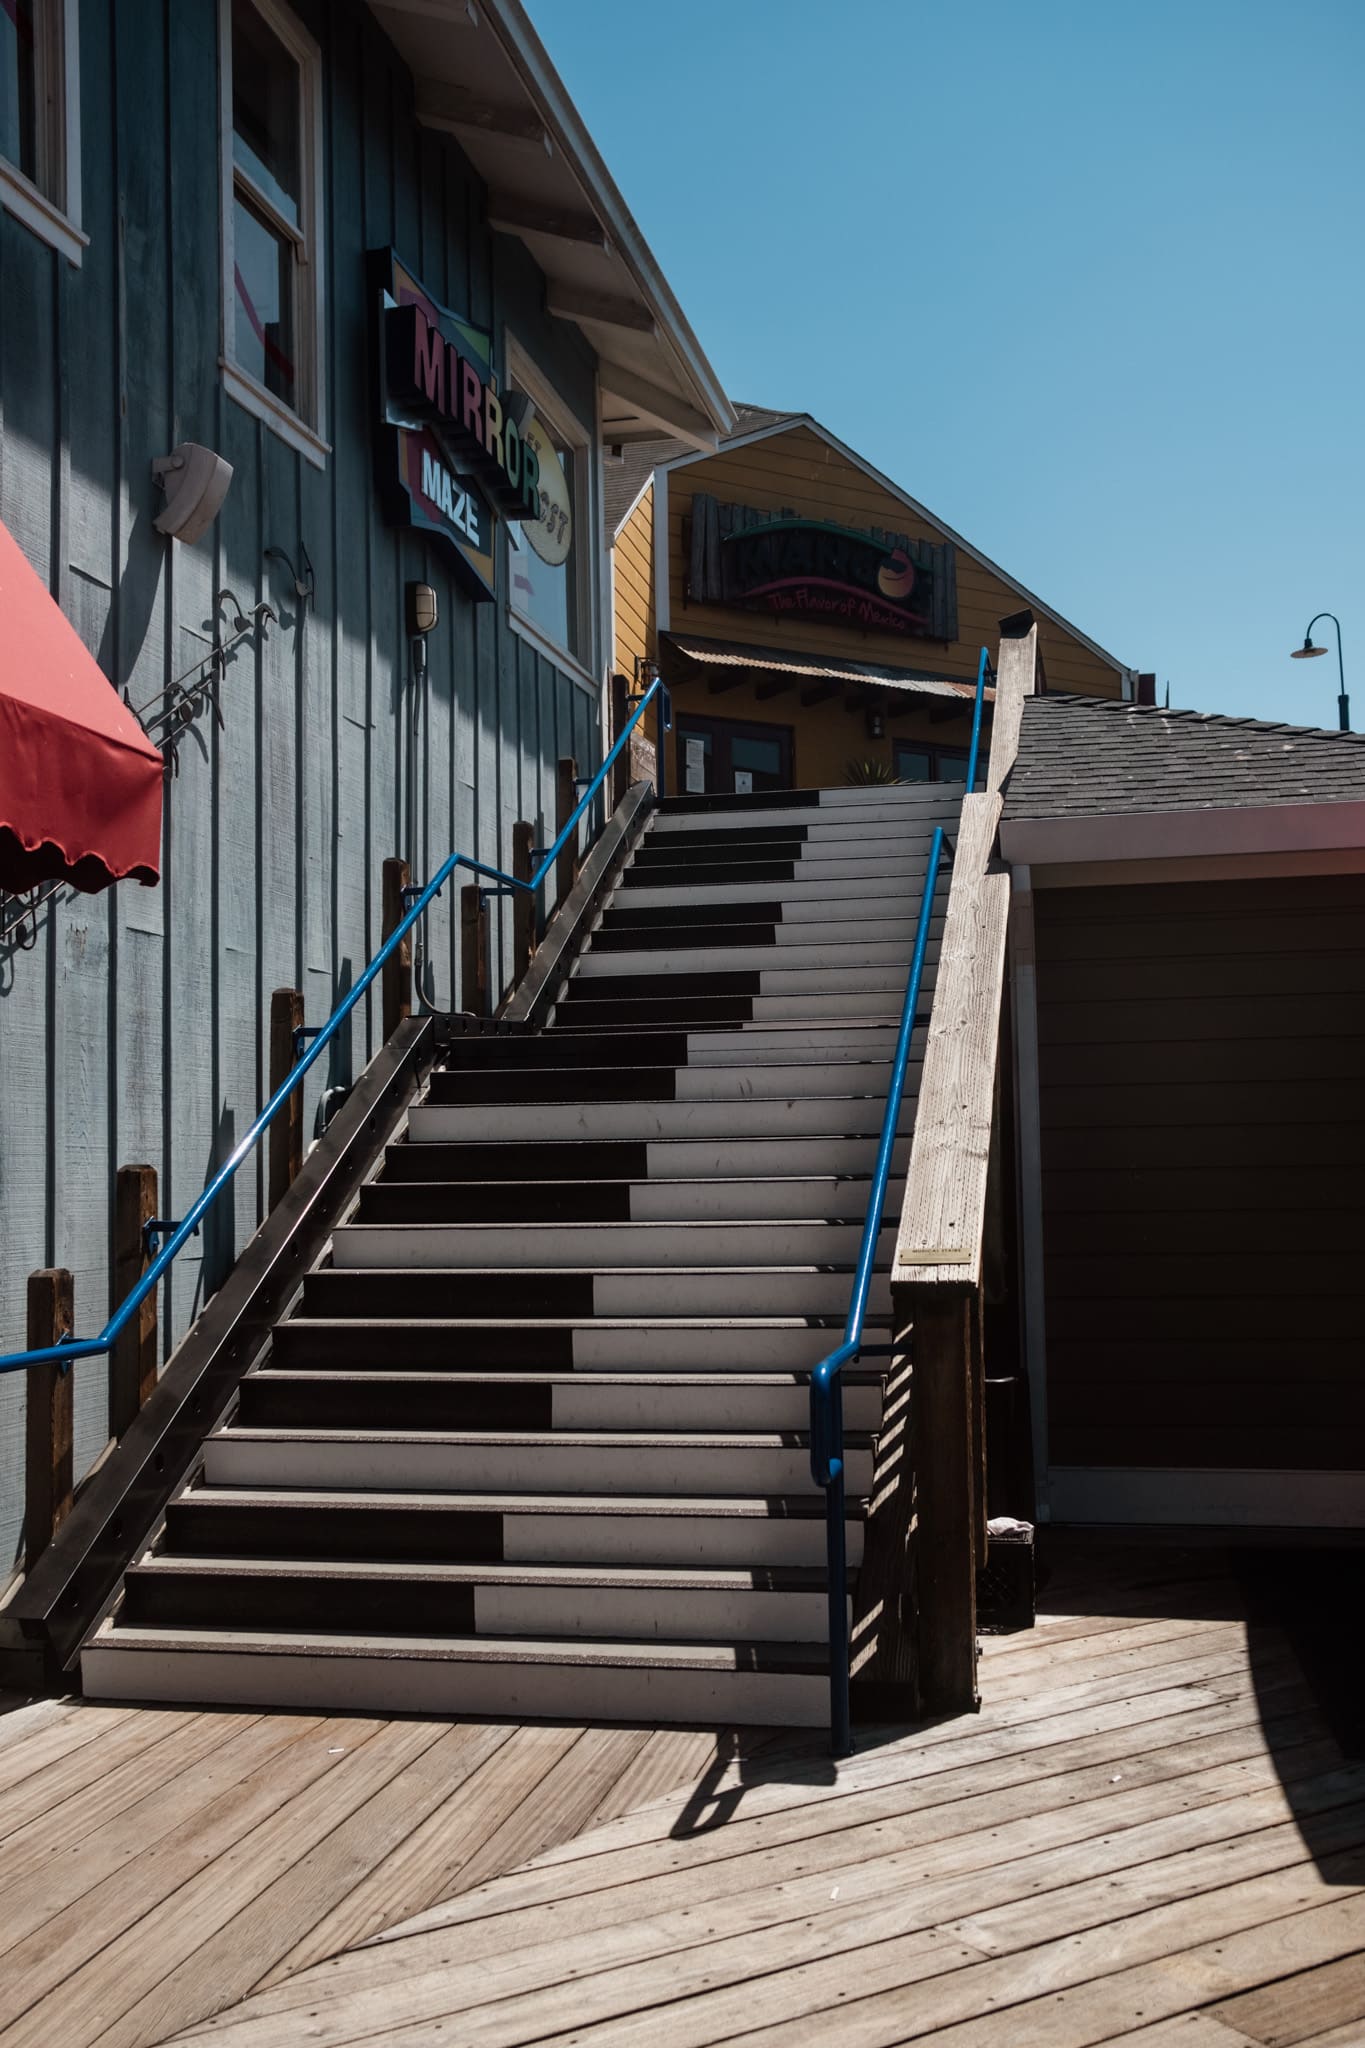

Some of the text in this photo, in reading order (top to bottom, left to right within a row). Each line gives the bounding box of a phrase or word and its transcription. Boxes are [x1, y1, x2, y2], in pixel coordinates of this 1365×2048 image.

[414, 304, 540, 520] MIRROR
[422, 448, 480, 547] MAZE
[769, 588, 905, 631] The Flavor of Mexico
